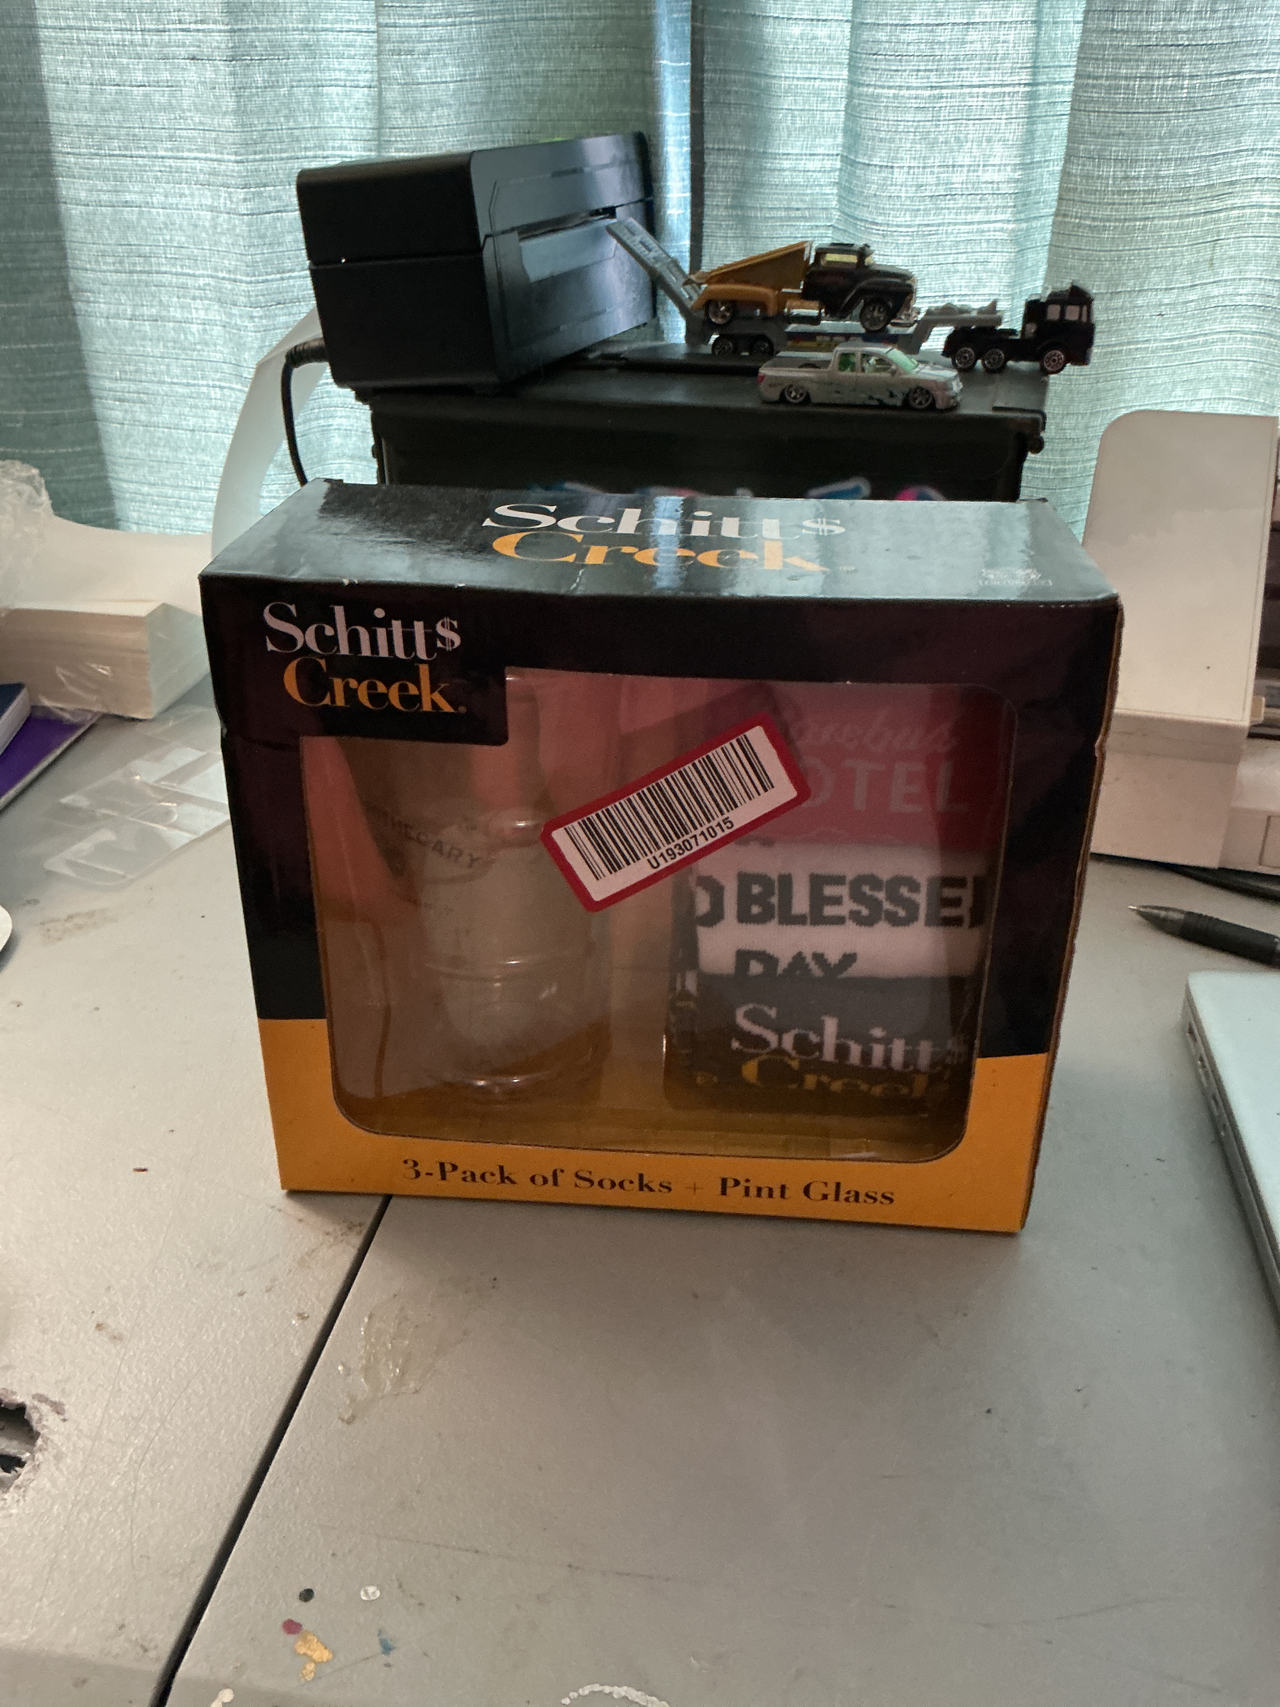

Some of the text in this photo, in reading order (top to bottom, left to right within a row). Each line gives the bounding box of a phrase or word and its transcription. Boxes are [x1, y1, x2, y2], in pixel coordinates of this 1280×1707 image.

[262, 601, 462, 661] Schitt$
[800, 758, 970, 815] OTEL
[647, 816, 735, 871] U193071015
[402, 1158, 517, 1186] 3-Pack
[529, 1168, 565, 1188] of
[574, 1168, 673, 1194] Socks
[719, 1176, 790, 1200] Pint
[802, 1180, 895, 1206] Glass
